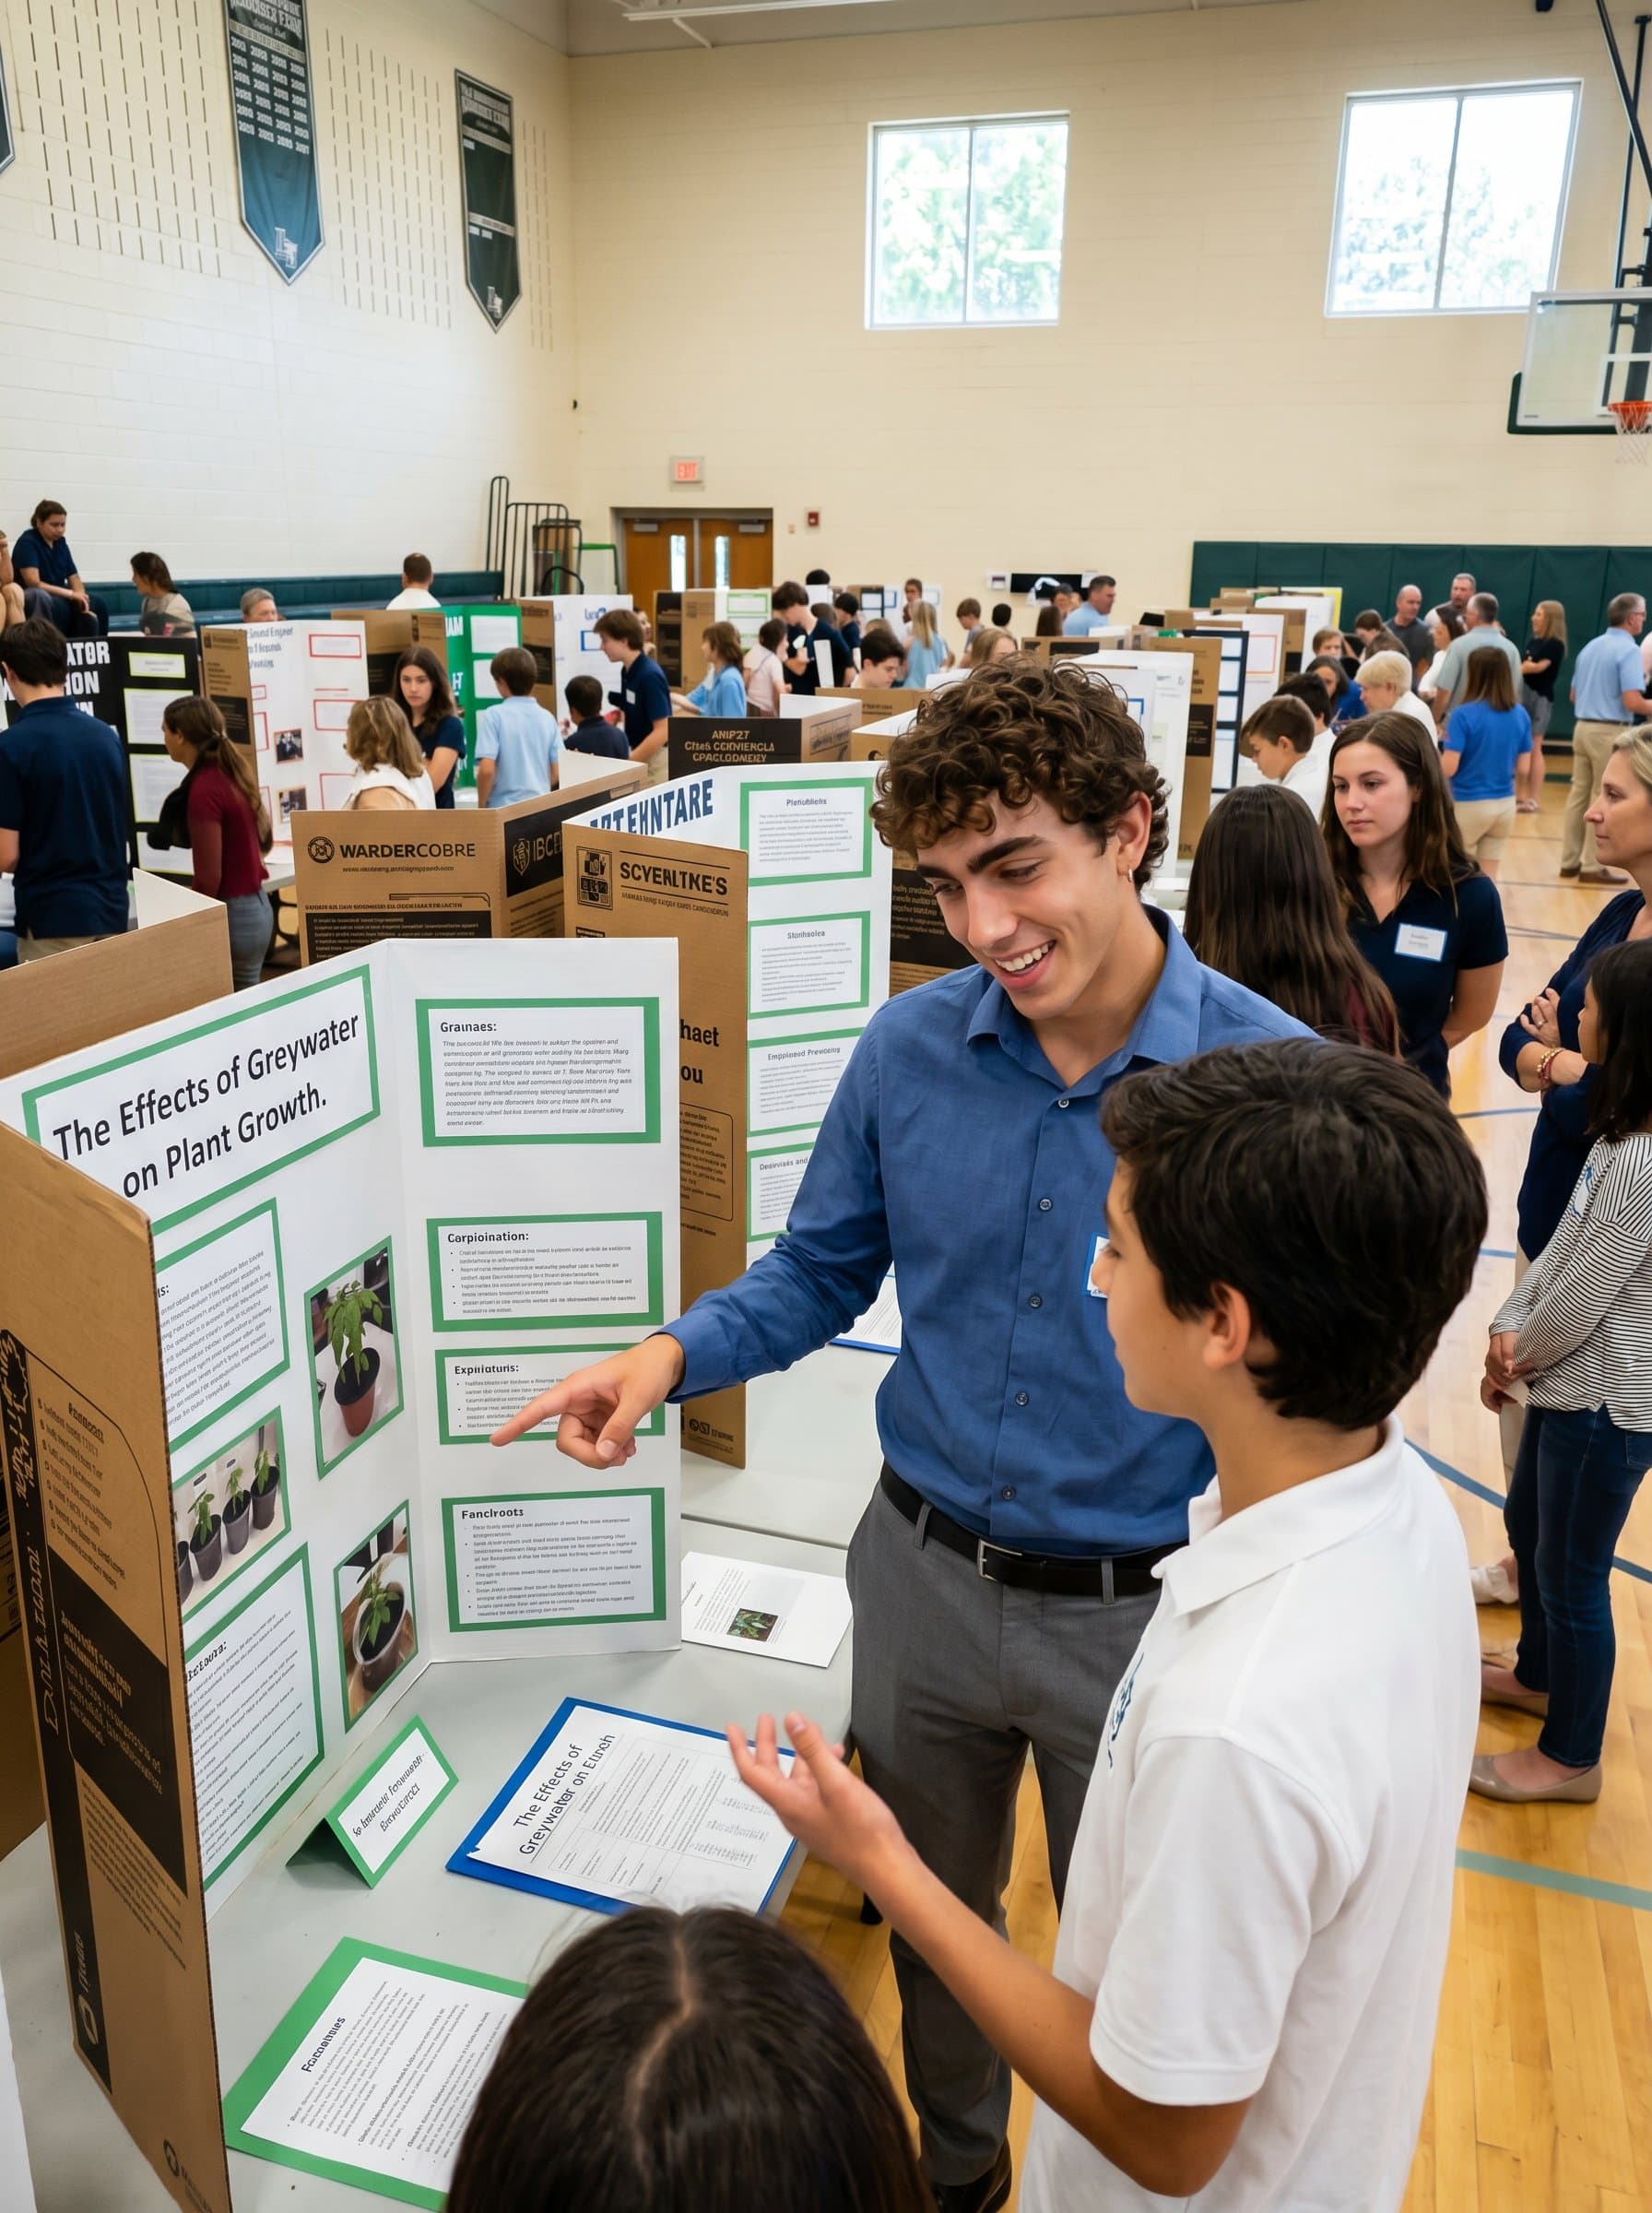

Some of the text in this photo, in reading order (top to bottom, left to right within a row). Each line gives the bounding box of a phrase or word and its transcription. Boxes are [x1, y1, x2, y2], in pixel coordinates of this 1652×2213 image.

[339, 843, 476, 858] WARDERCOBRE
[53, 1014, 360, 1161] The Effects of Greywater
[123, 1083, 326, 1199] on Plant Growth.
[447, 1231, 529, 1244] Carpioination:
[513, 1743, 584, 1828] The Effects of
[572, 1770, 589, 1786] on
